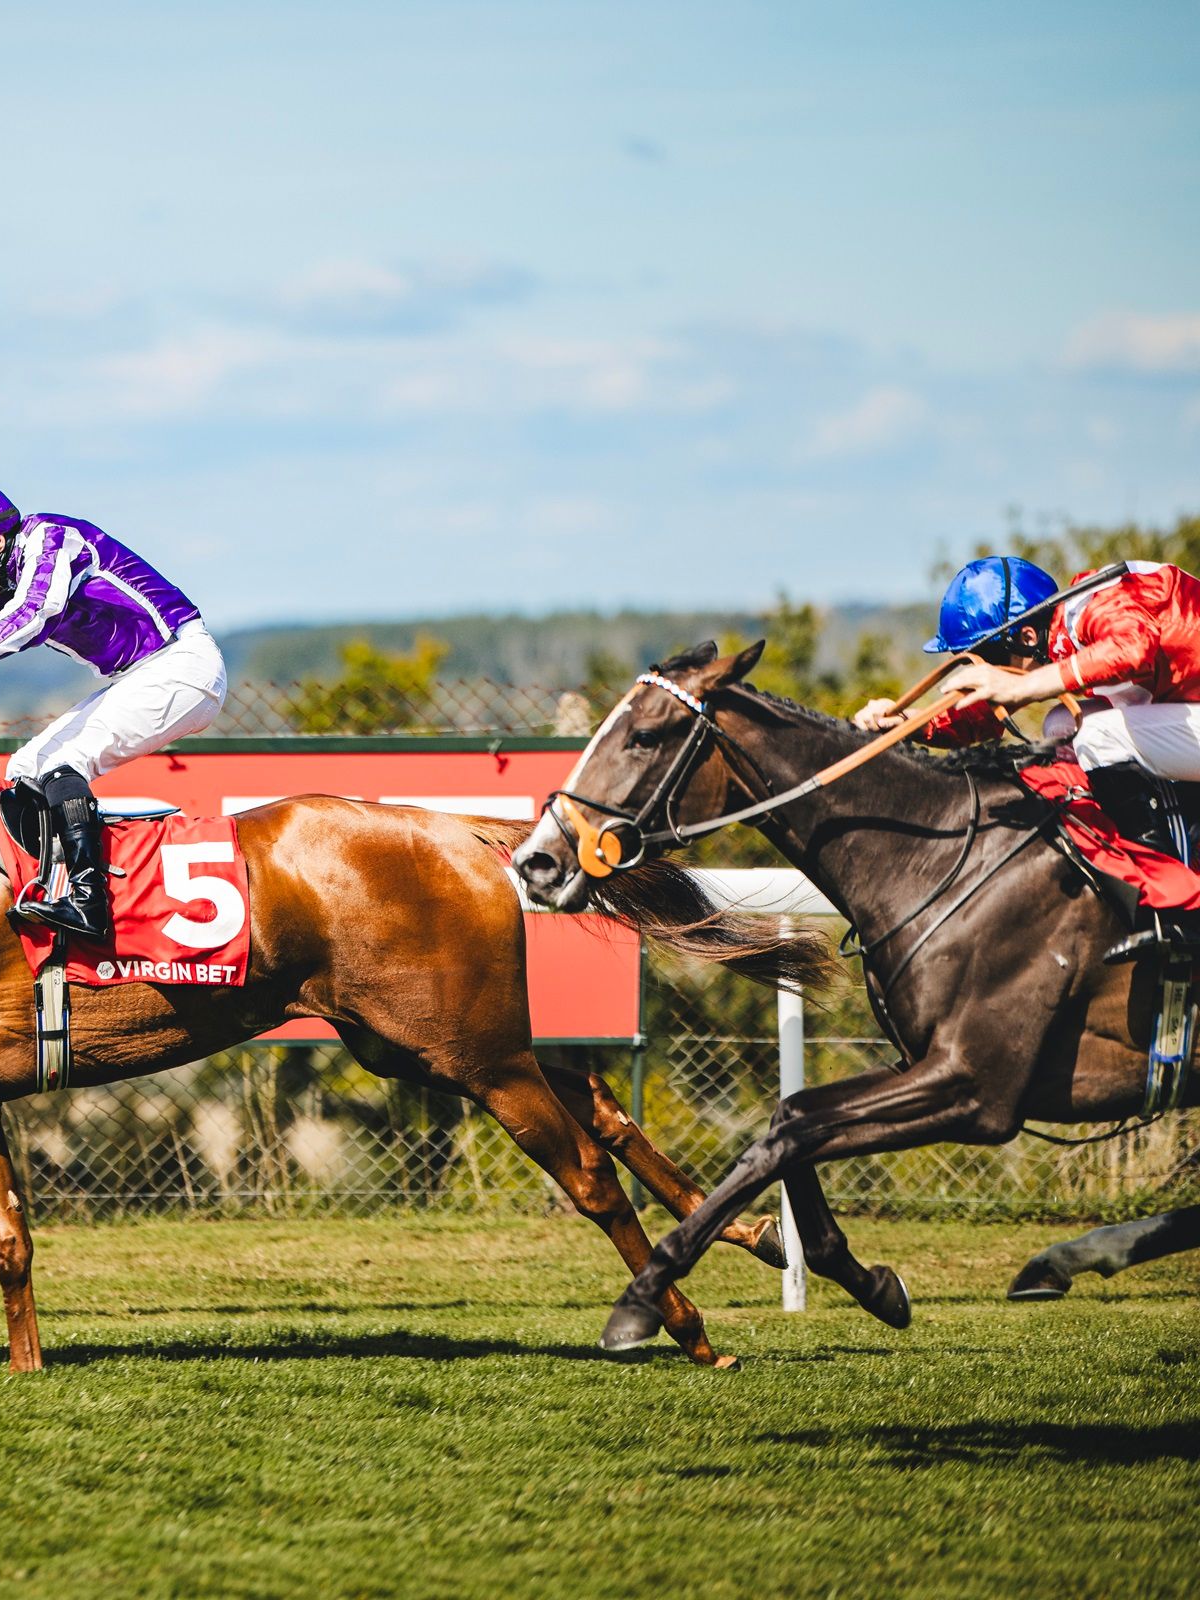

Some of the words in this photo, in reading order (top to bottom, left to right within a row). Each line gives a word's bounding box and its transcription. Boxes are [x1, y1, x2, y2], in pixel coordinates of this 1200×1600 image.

[160, 841, 245, 948] 5
[116, 960, 192, 981] VIRGIN
[195, 963, 237, 983] BET
